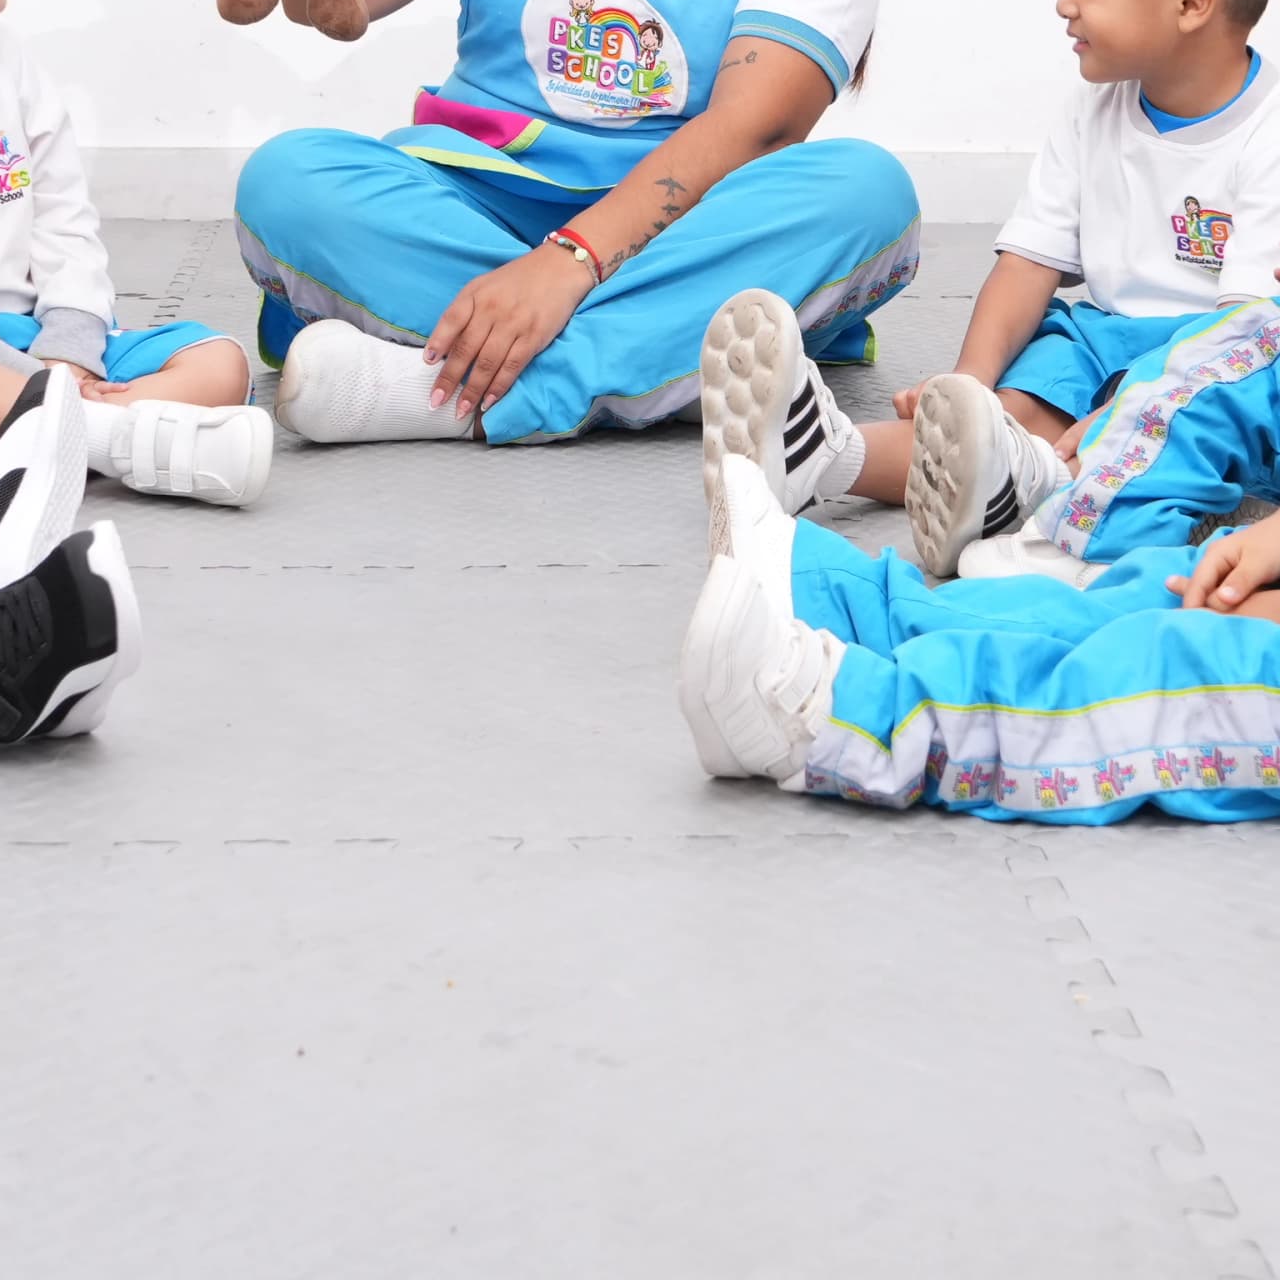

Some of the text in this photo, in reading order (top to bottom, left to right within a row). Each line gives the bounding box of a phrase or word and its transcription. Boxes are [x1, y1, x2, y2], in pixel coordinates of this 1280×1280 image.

[552, 19, 621, 58] PKES
[550, 49, 651, 94] SCHOOL
[1173, 216, 1226, 239] PKES
